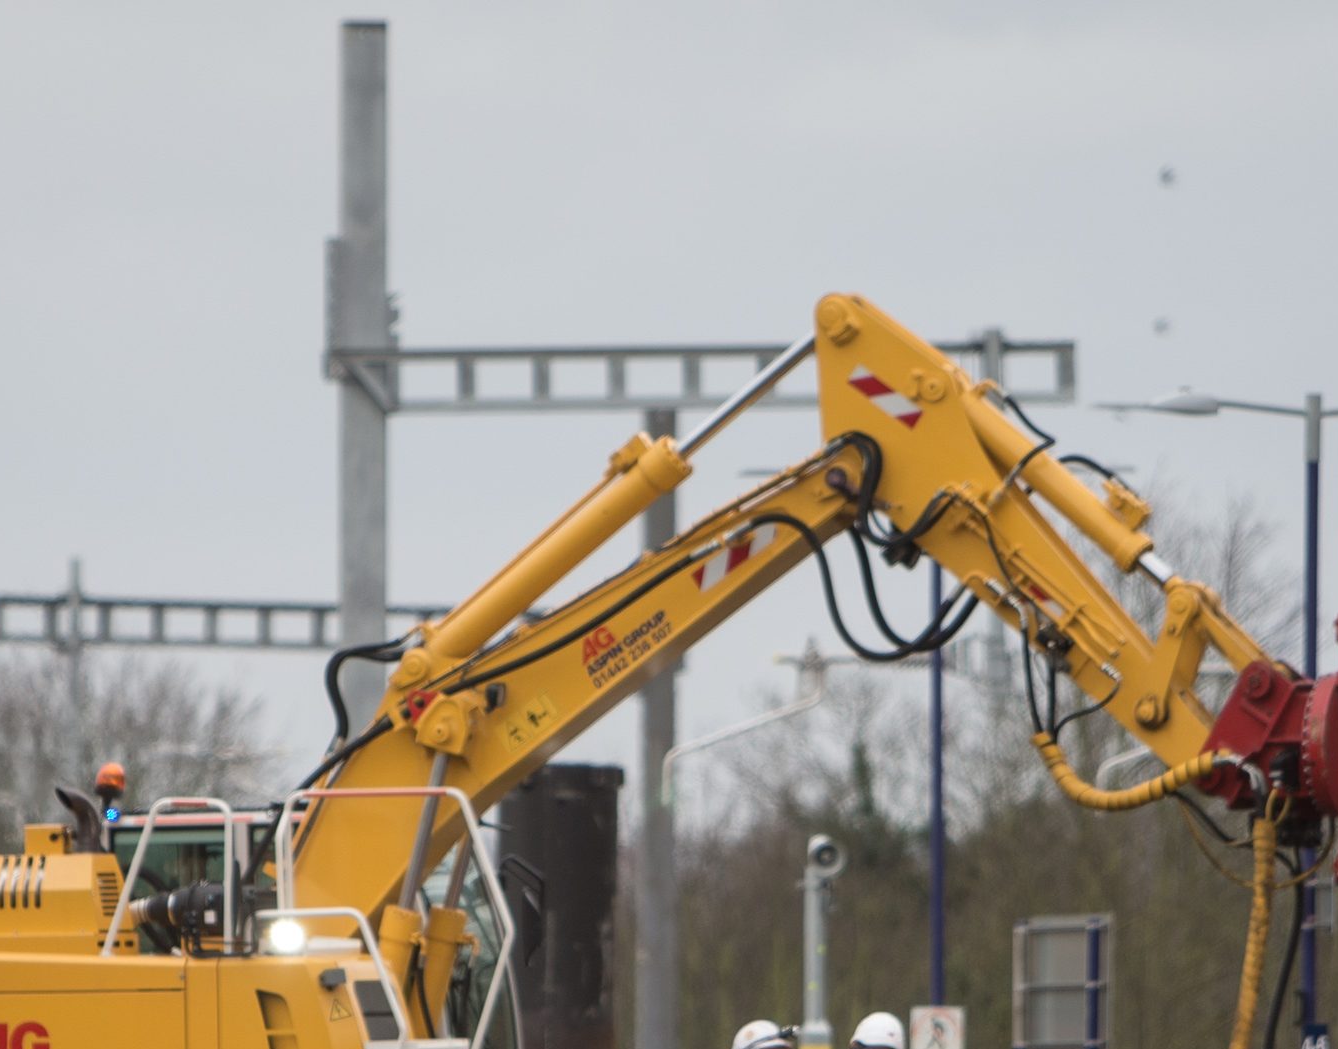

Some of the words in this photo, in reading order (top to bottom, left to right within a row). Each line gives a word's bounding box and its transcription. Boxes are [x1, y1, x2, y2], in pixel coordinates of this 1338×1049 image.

[583, 626, 614, 666] AG
[588, 645, 622, 676] ASPIN
[624, 610, 665, 646] GROUP
